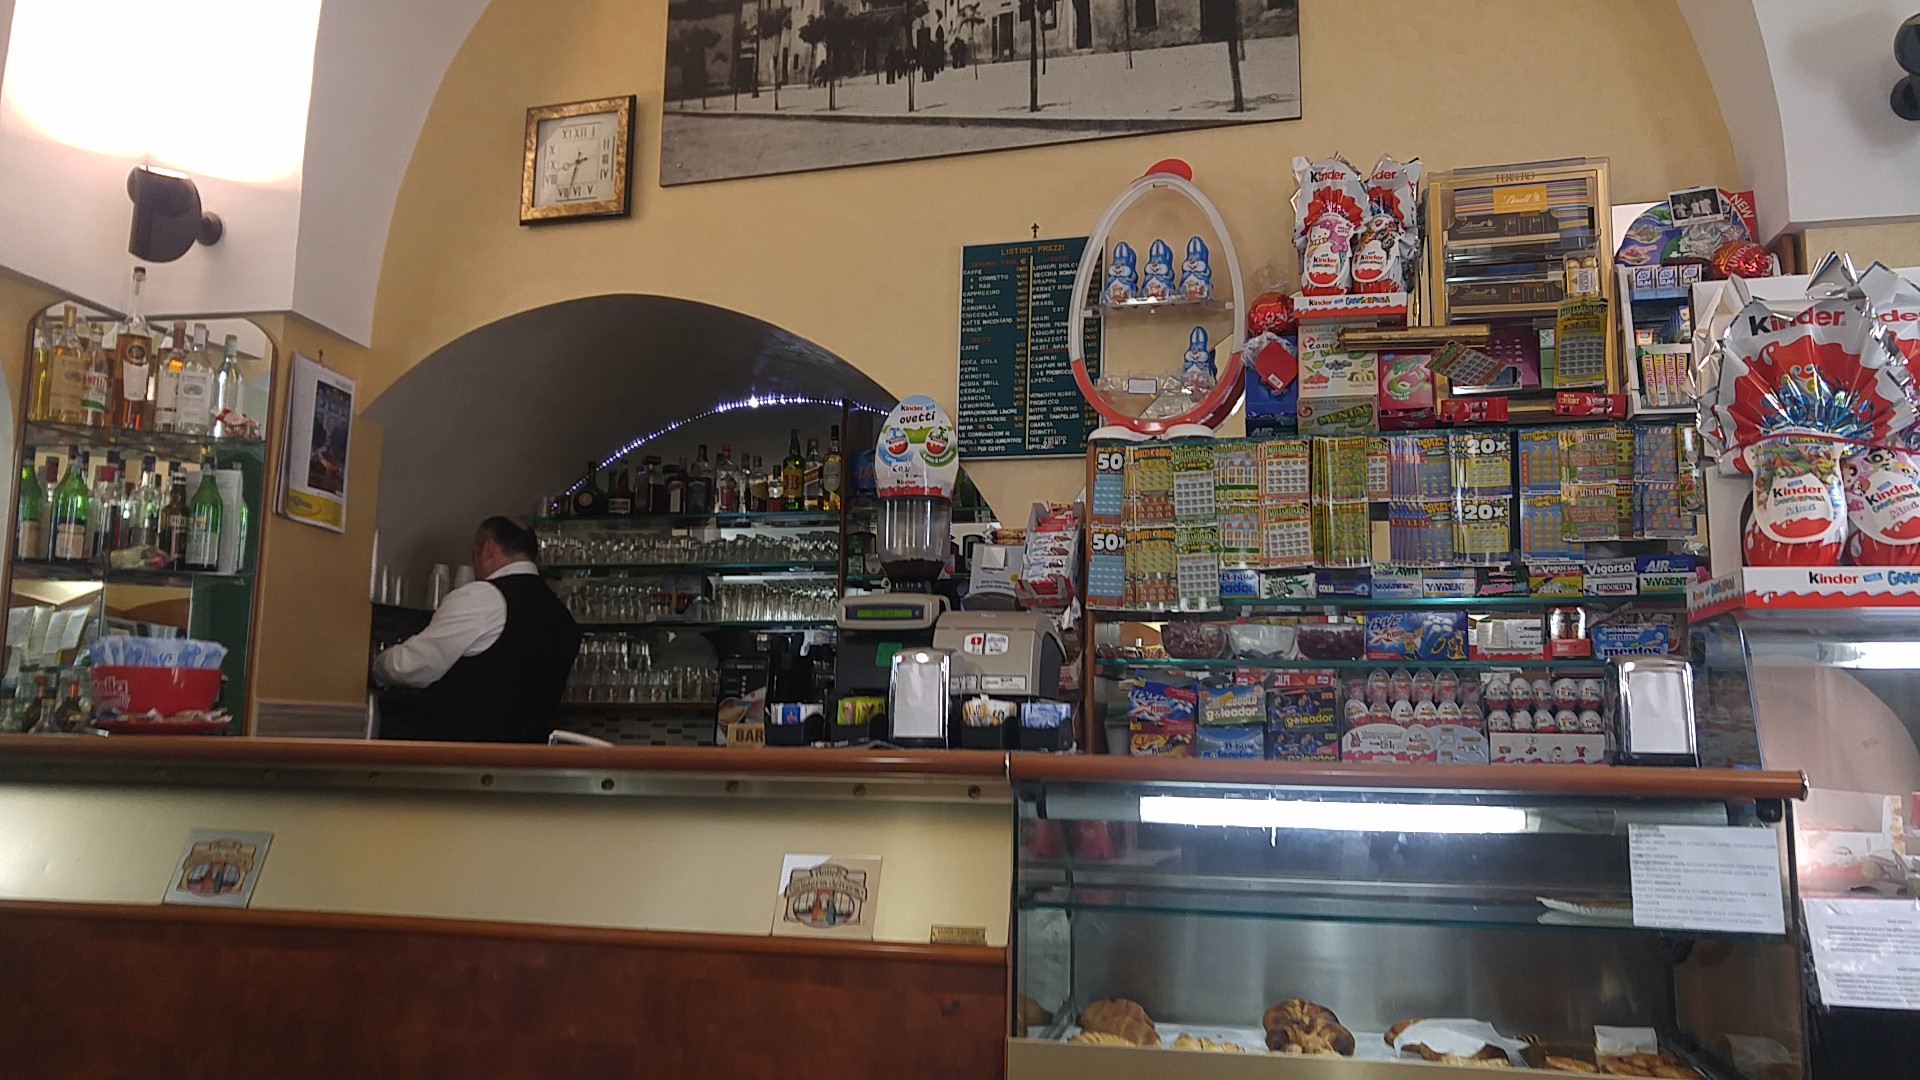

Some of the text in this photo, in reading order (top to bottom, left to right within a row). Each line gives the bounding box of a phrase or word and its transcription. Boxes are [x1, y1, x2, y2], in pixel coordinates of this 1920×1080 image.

[1310, 170, 1347, 183] Kinder
[1372, 170, 1397, 180] der
[1730, 194, 1754, 219] NEW
[1001, 247, 1033, 255] LISTINO
[1313, 256, 1337, 264] Kinder
[962, 311, 999, 319] CIOCCOLATA
[1749, 307, 1848, 336] Kinder
[900, 411, 935, 424] ovetti
[1252, 427, 1274, 436] AIR
[1098, 453, 1124, 470] 50
[1773, 486, 1823, 498] Kinder
[1865, 482, 1915, 506] Kinder
[1584, 561, 1635, 576] Vigorsol
[1646, 560, 1669, 572] AIR
[1809, 571, 1858, 585] Kinder
[736, 730, 763, 742] BAR
